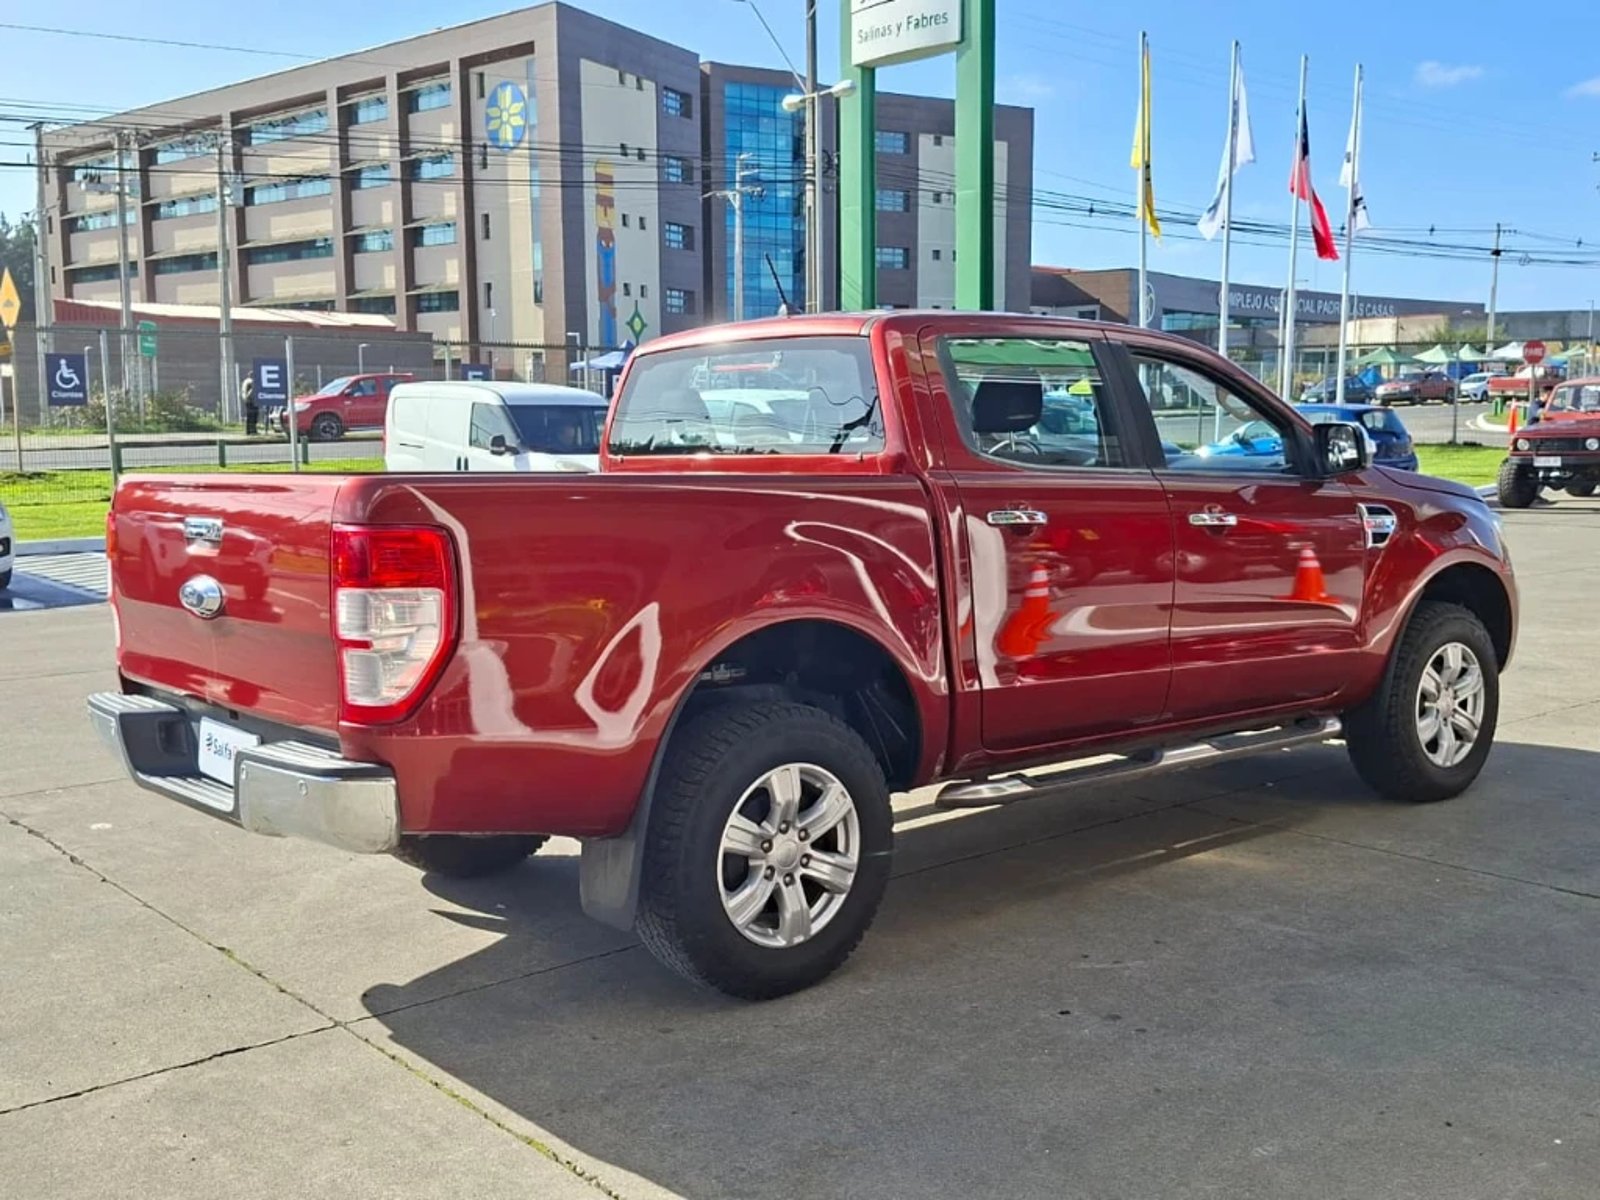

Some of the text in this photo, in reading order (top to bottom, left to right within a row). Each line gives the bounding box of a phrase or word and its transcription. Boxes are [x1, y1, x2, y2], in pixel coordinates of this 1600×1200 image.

[857, 11, 949, 44] Salinas y Fabres
[261, 365, 280, 388] E
